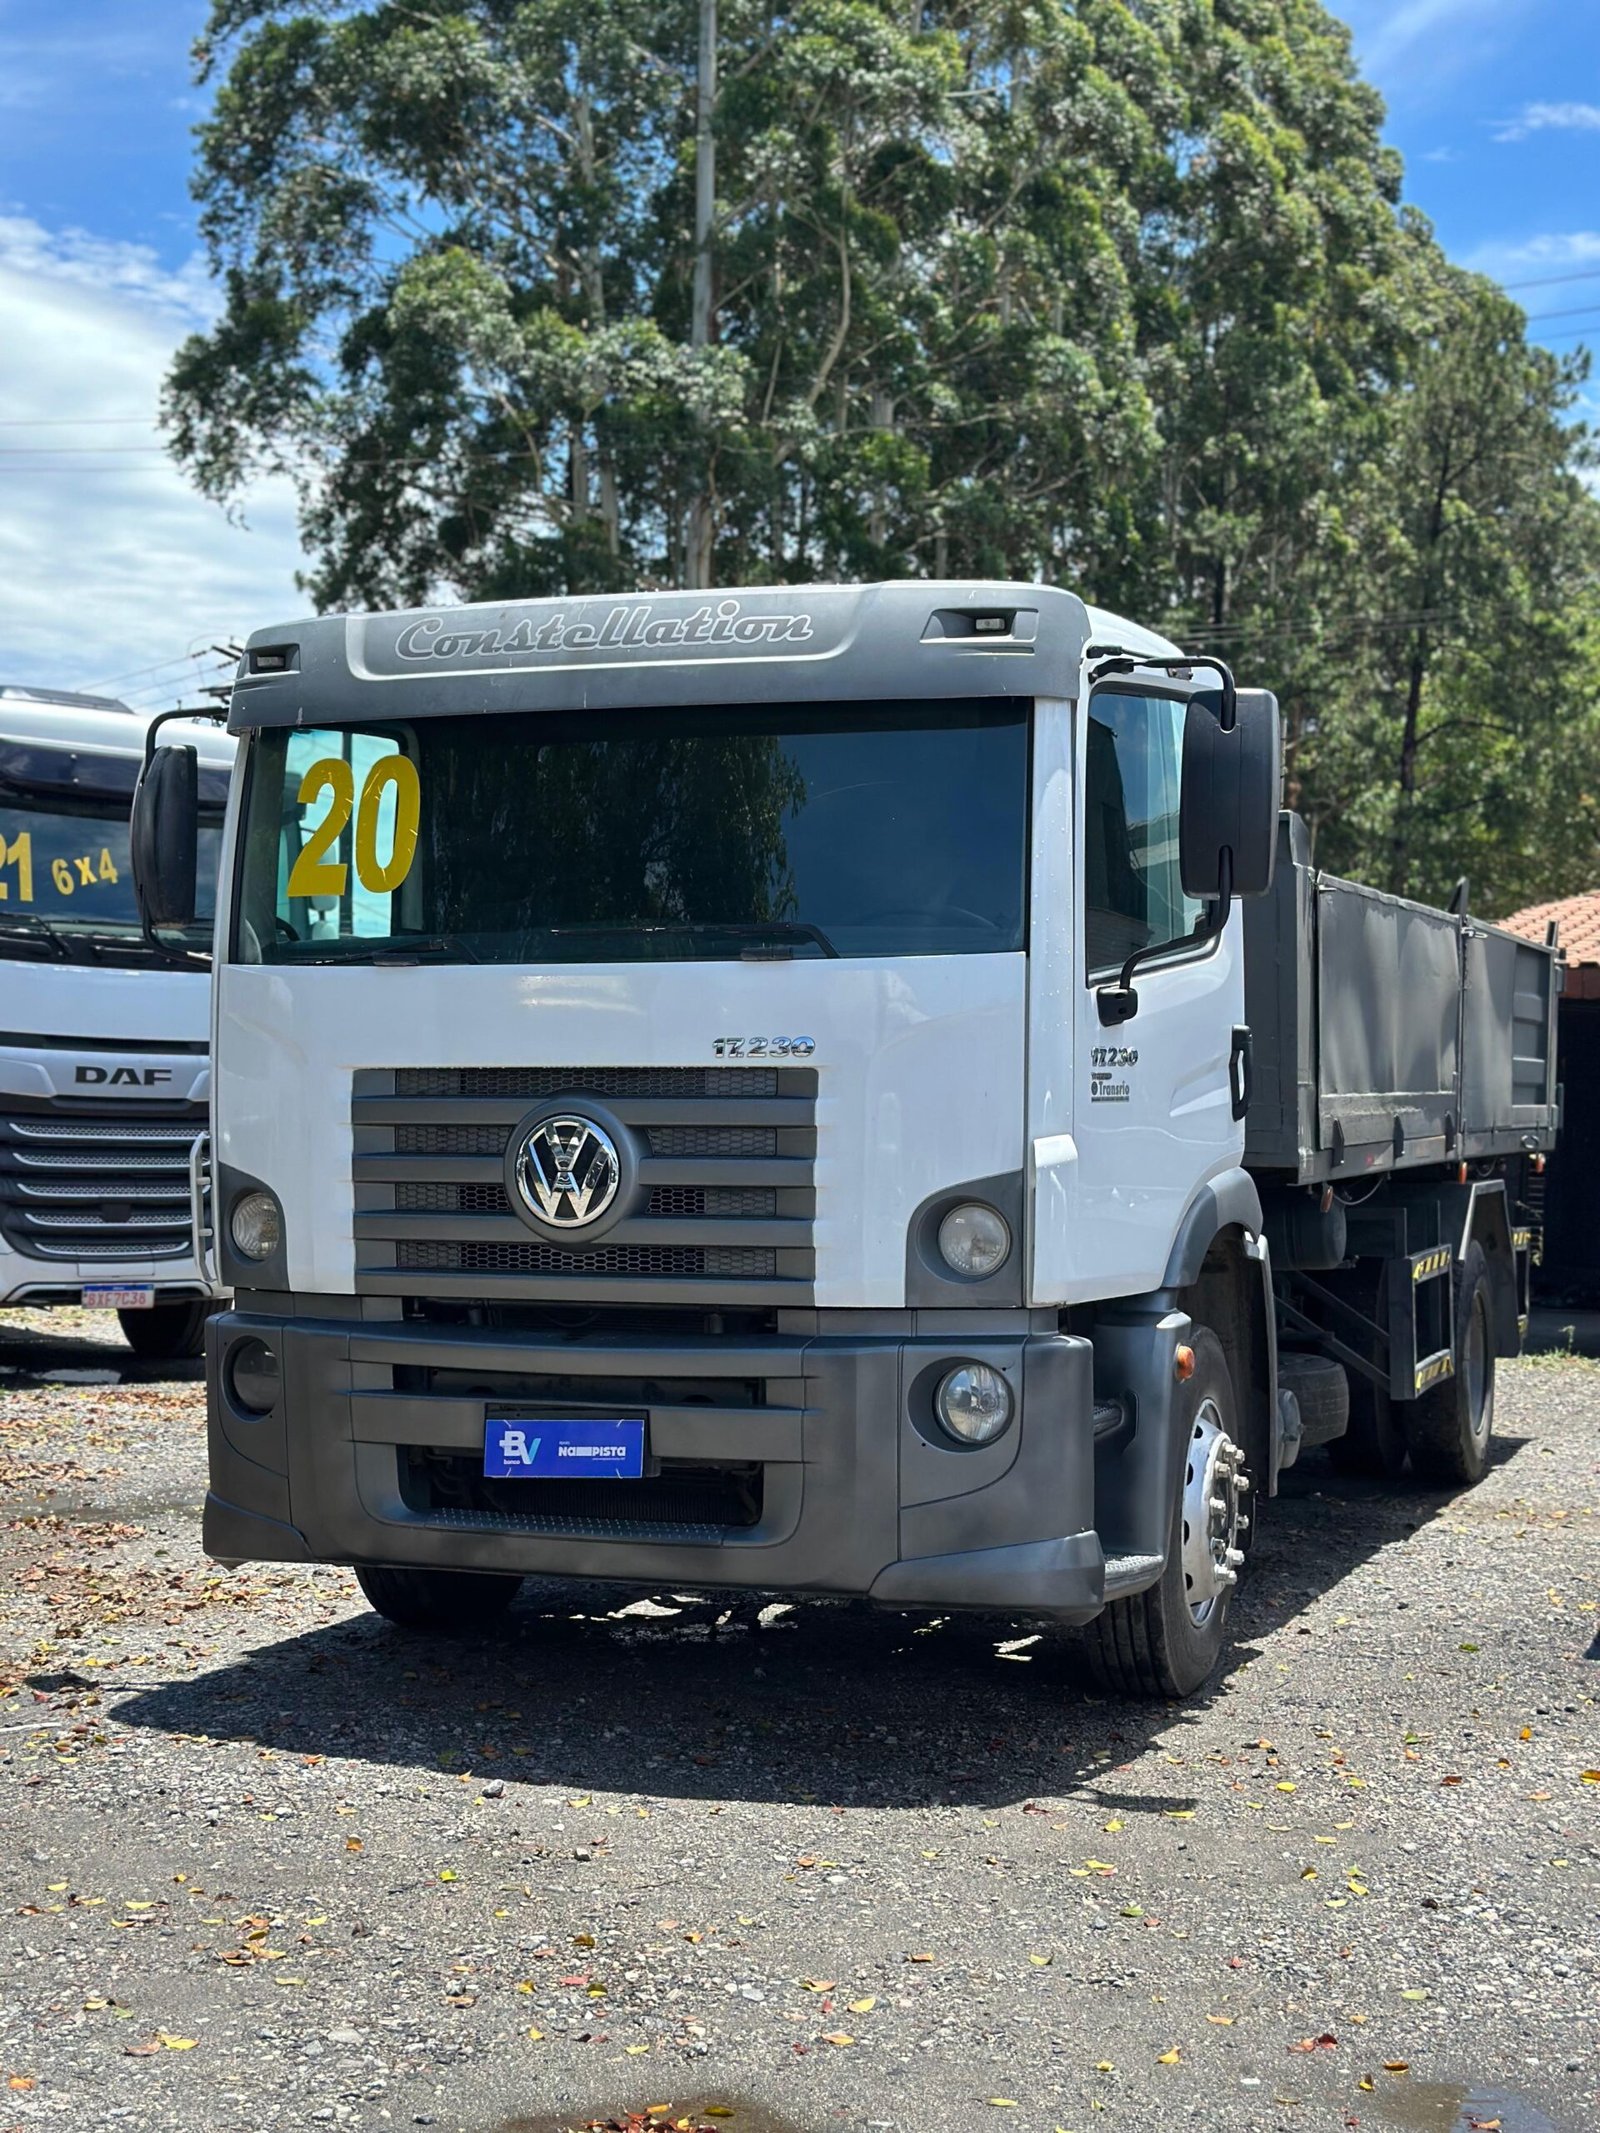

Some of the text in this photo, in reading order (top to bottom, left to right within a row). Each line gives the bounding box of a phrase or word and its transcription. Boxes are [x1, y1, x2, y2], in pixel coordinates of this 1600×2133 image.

[395, 600, 814, 660] Constellation
[287, 754, 420, 897] 20
[712, 1036, 816, 1058] 17.230
[75, 1066, 172, 1085] DAF
[517, 1115, 618, 1227] VW
[499, 1430, 541, 1465] BV
